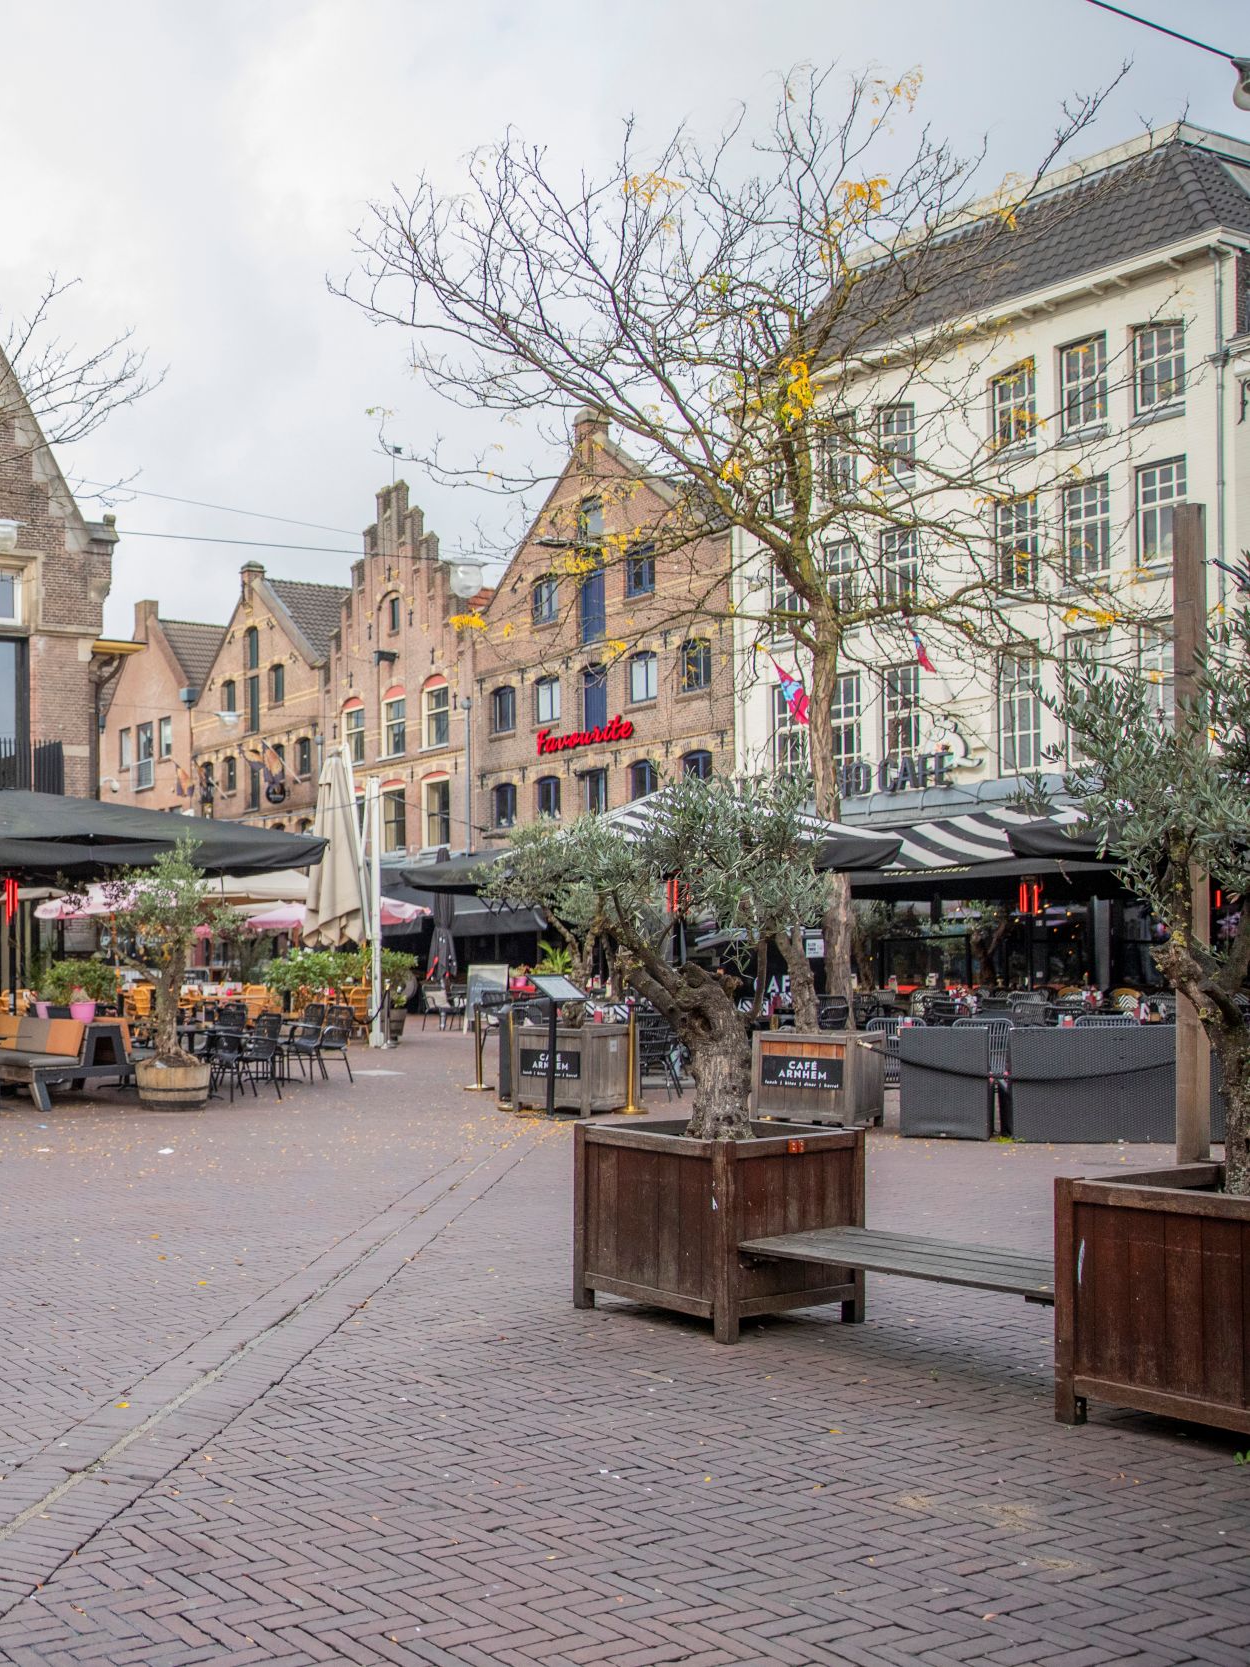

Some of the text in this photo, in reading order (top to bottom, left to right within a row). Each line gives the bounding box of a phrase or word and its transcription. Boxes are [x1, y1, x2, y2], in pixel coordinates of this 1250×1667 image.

[536, 714, 633, 756] Favourite
[532, 1060, 569, 1071] ARNEM
[788, 1060, 818, 1071] CAFÉ
[778, 1069, 827, 1080] ARNHEM
